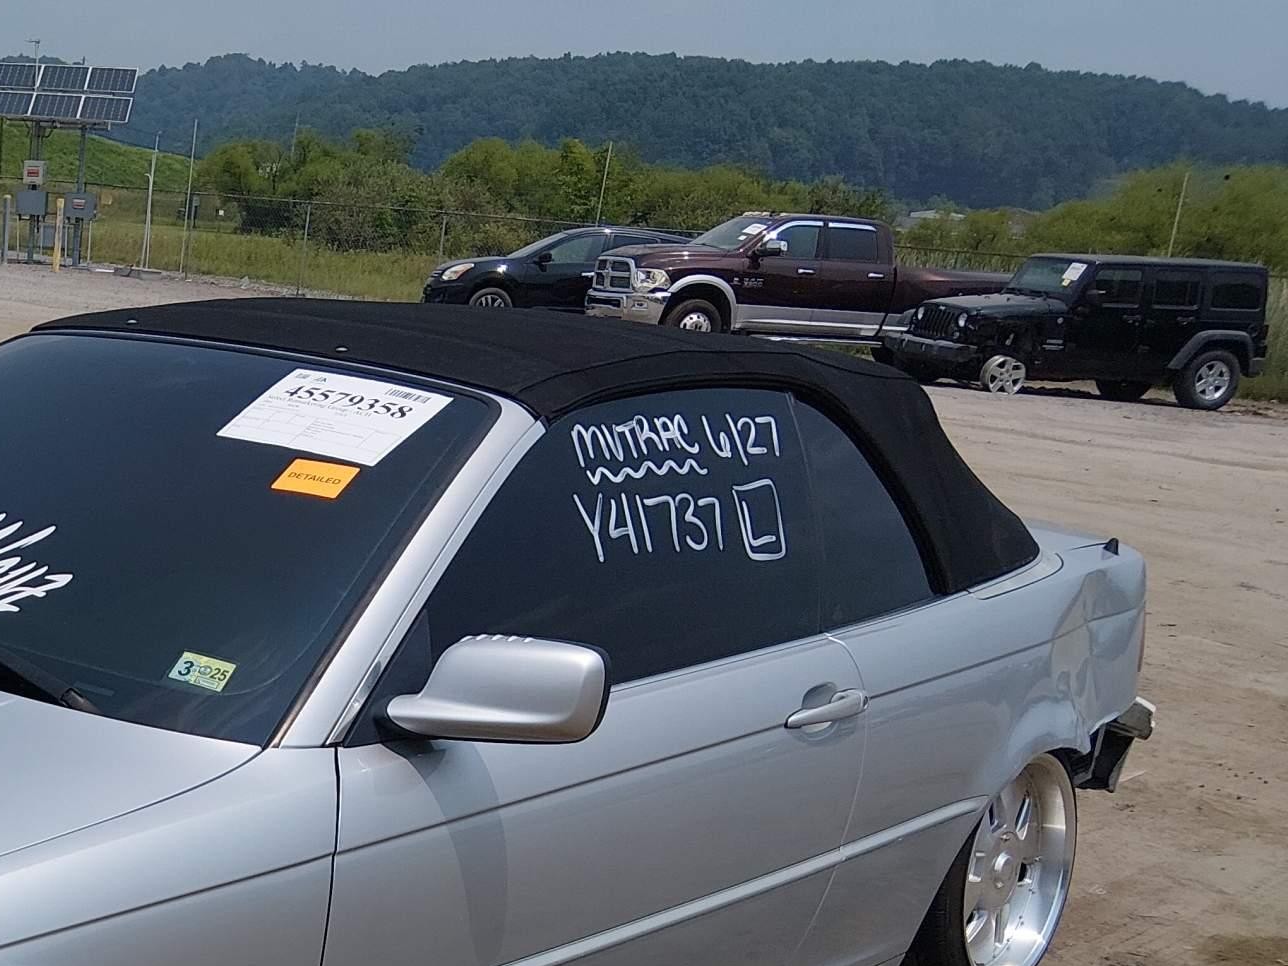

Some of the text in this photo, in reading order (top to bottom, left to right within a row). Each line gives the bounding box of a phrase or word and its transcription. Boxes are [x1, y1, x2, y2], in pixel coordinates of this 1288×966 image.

[285, 385, 414, 419] 45579358
[701, 413, 780, 466] 6/27
[287, 471, 342, 486] DETAILED
[573, 493, 724, 563] Y41737
[178, 660, 230, 682] 3 25
